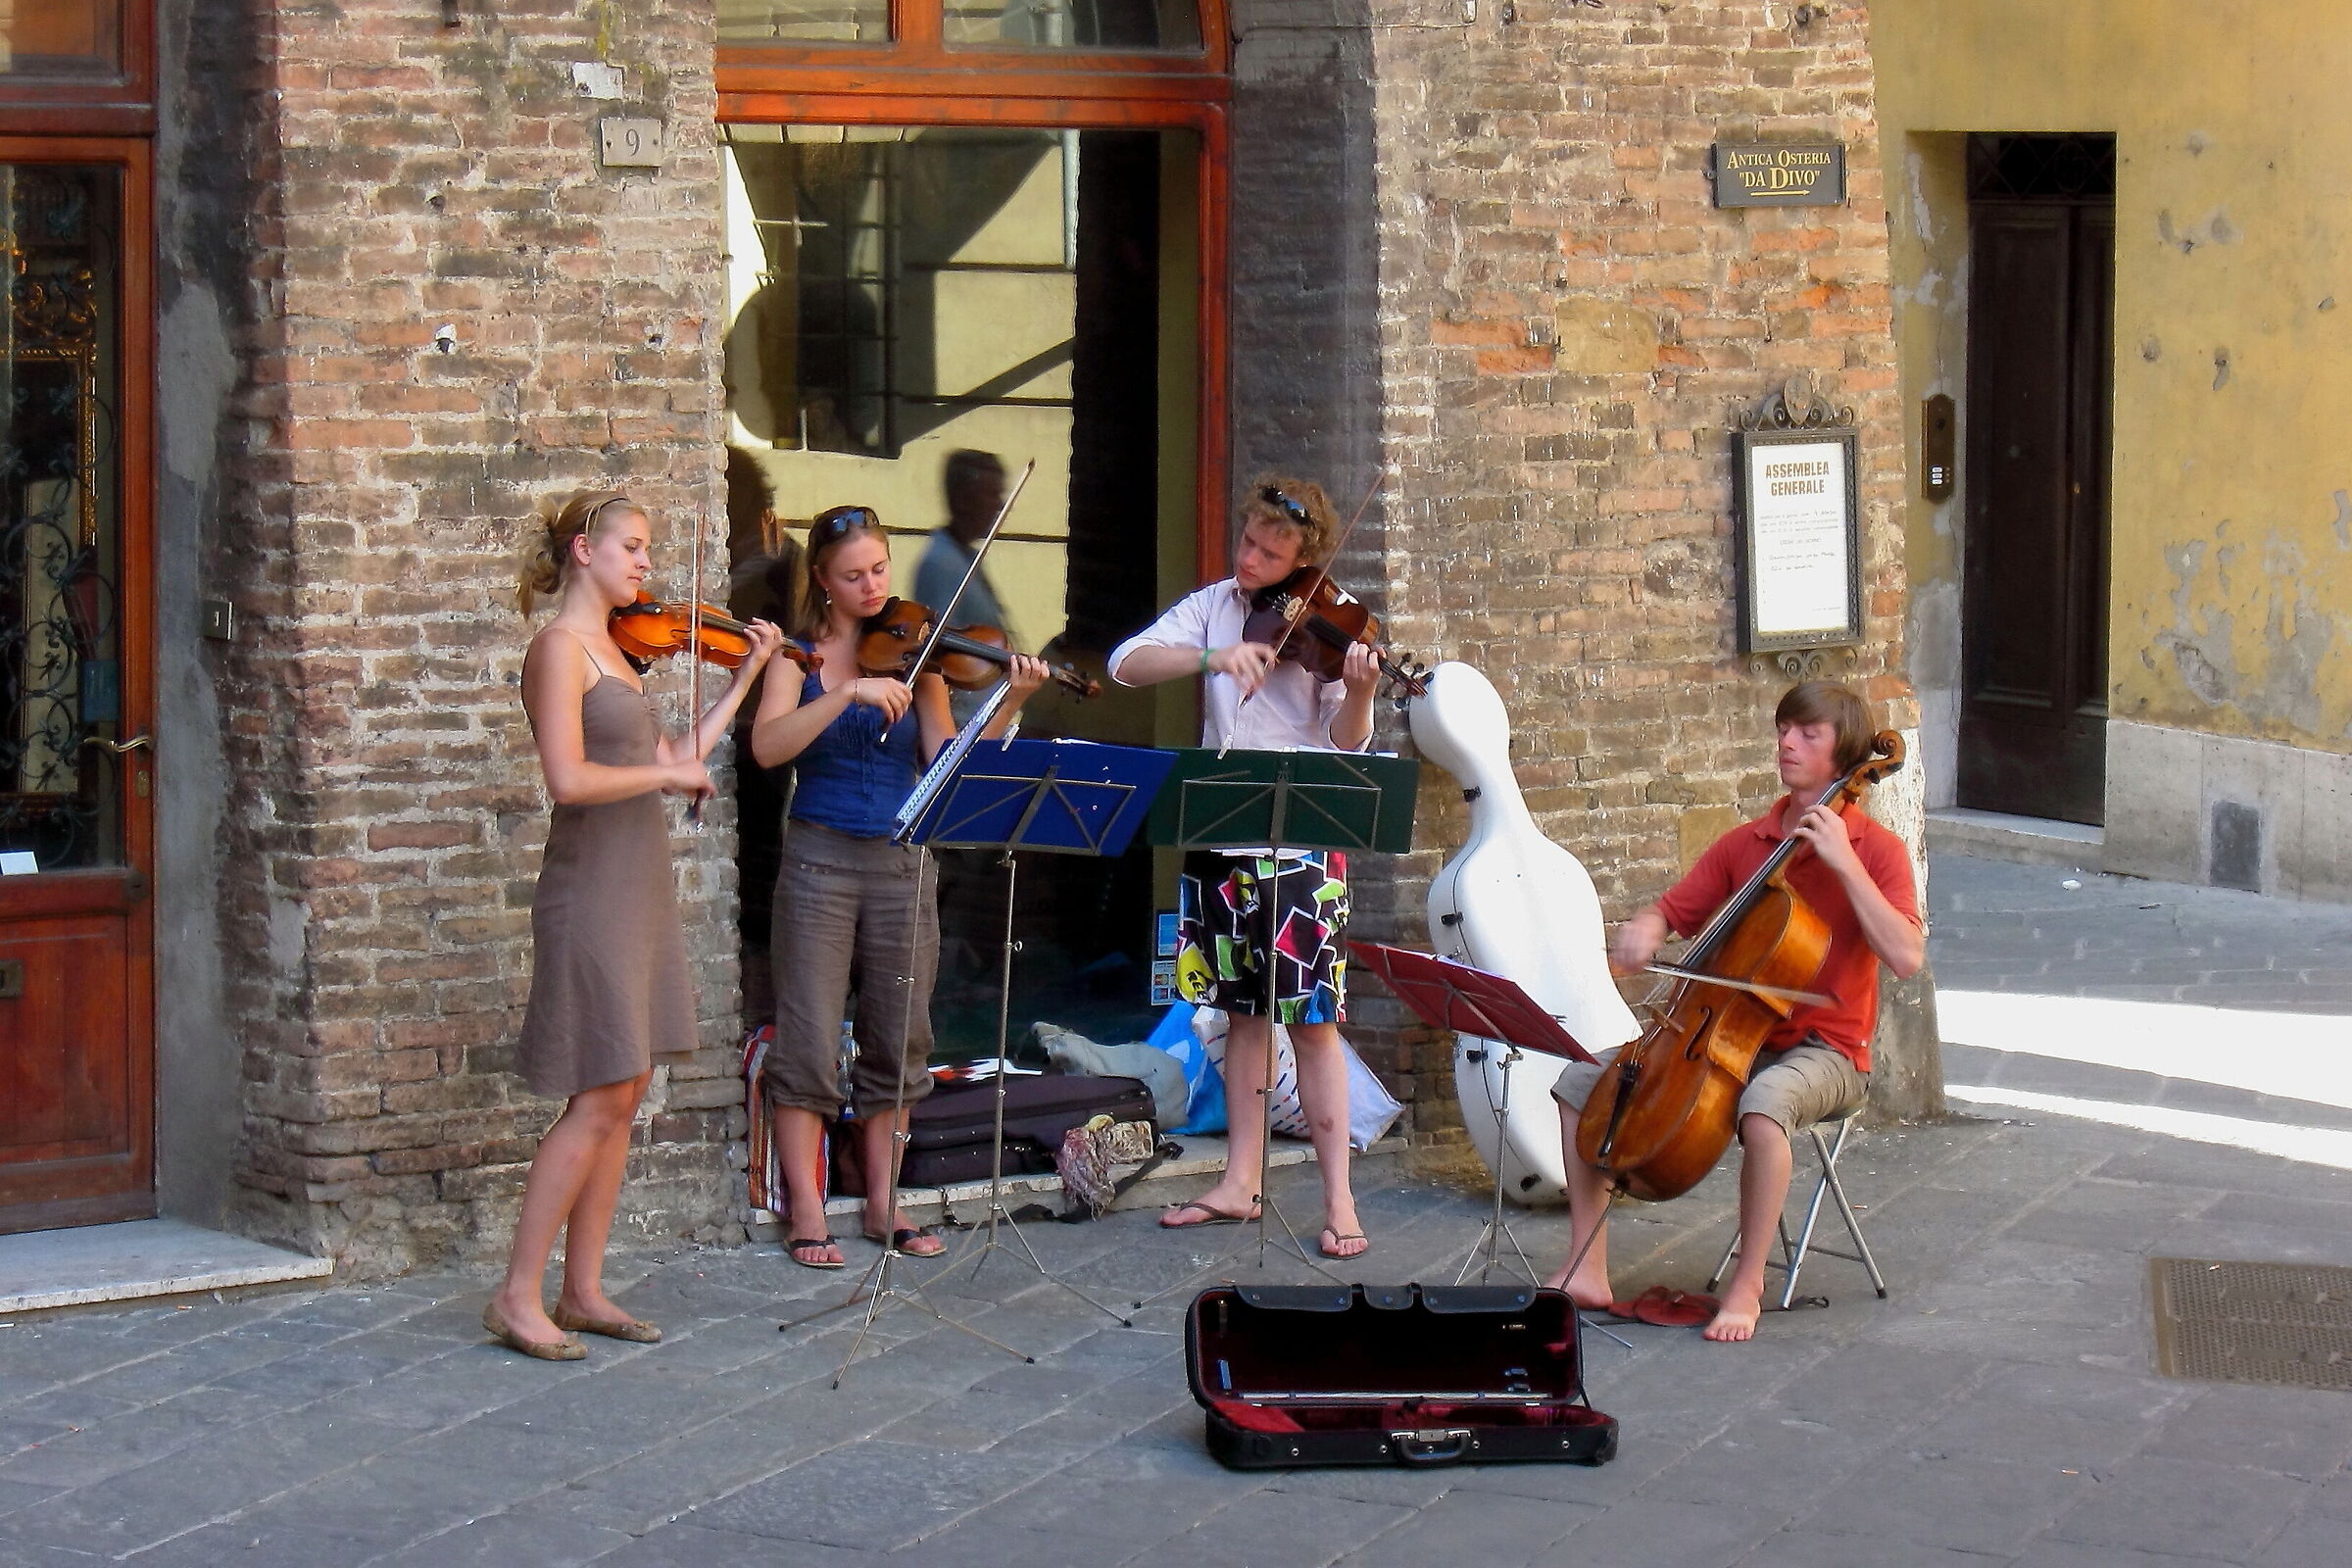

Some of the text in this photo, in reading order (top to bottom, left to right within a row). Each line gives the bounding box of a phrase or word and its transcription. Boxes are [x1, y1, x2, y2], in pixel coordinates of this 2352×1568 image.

[625, 128, 641, 157] 9
[1727, 149, 1832, 170] ANTICA OSTERIA
[1740, 167, 1821, 189] "DA DIVO"
[1765, 461, 1830, 479] ASSEMBLEA
[1771, 478, 1825, 497] GENERALE
